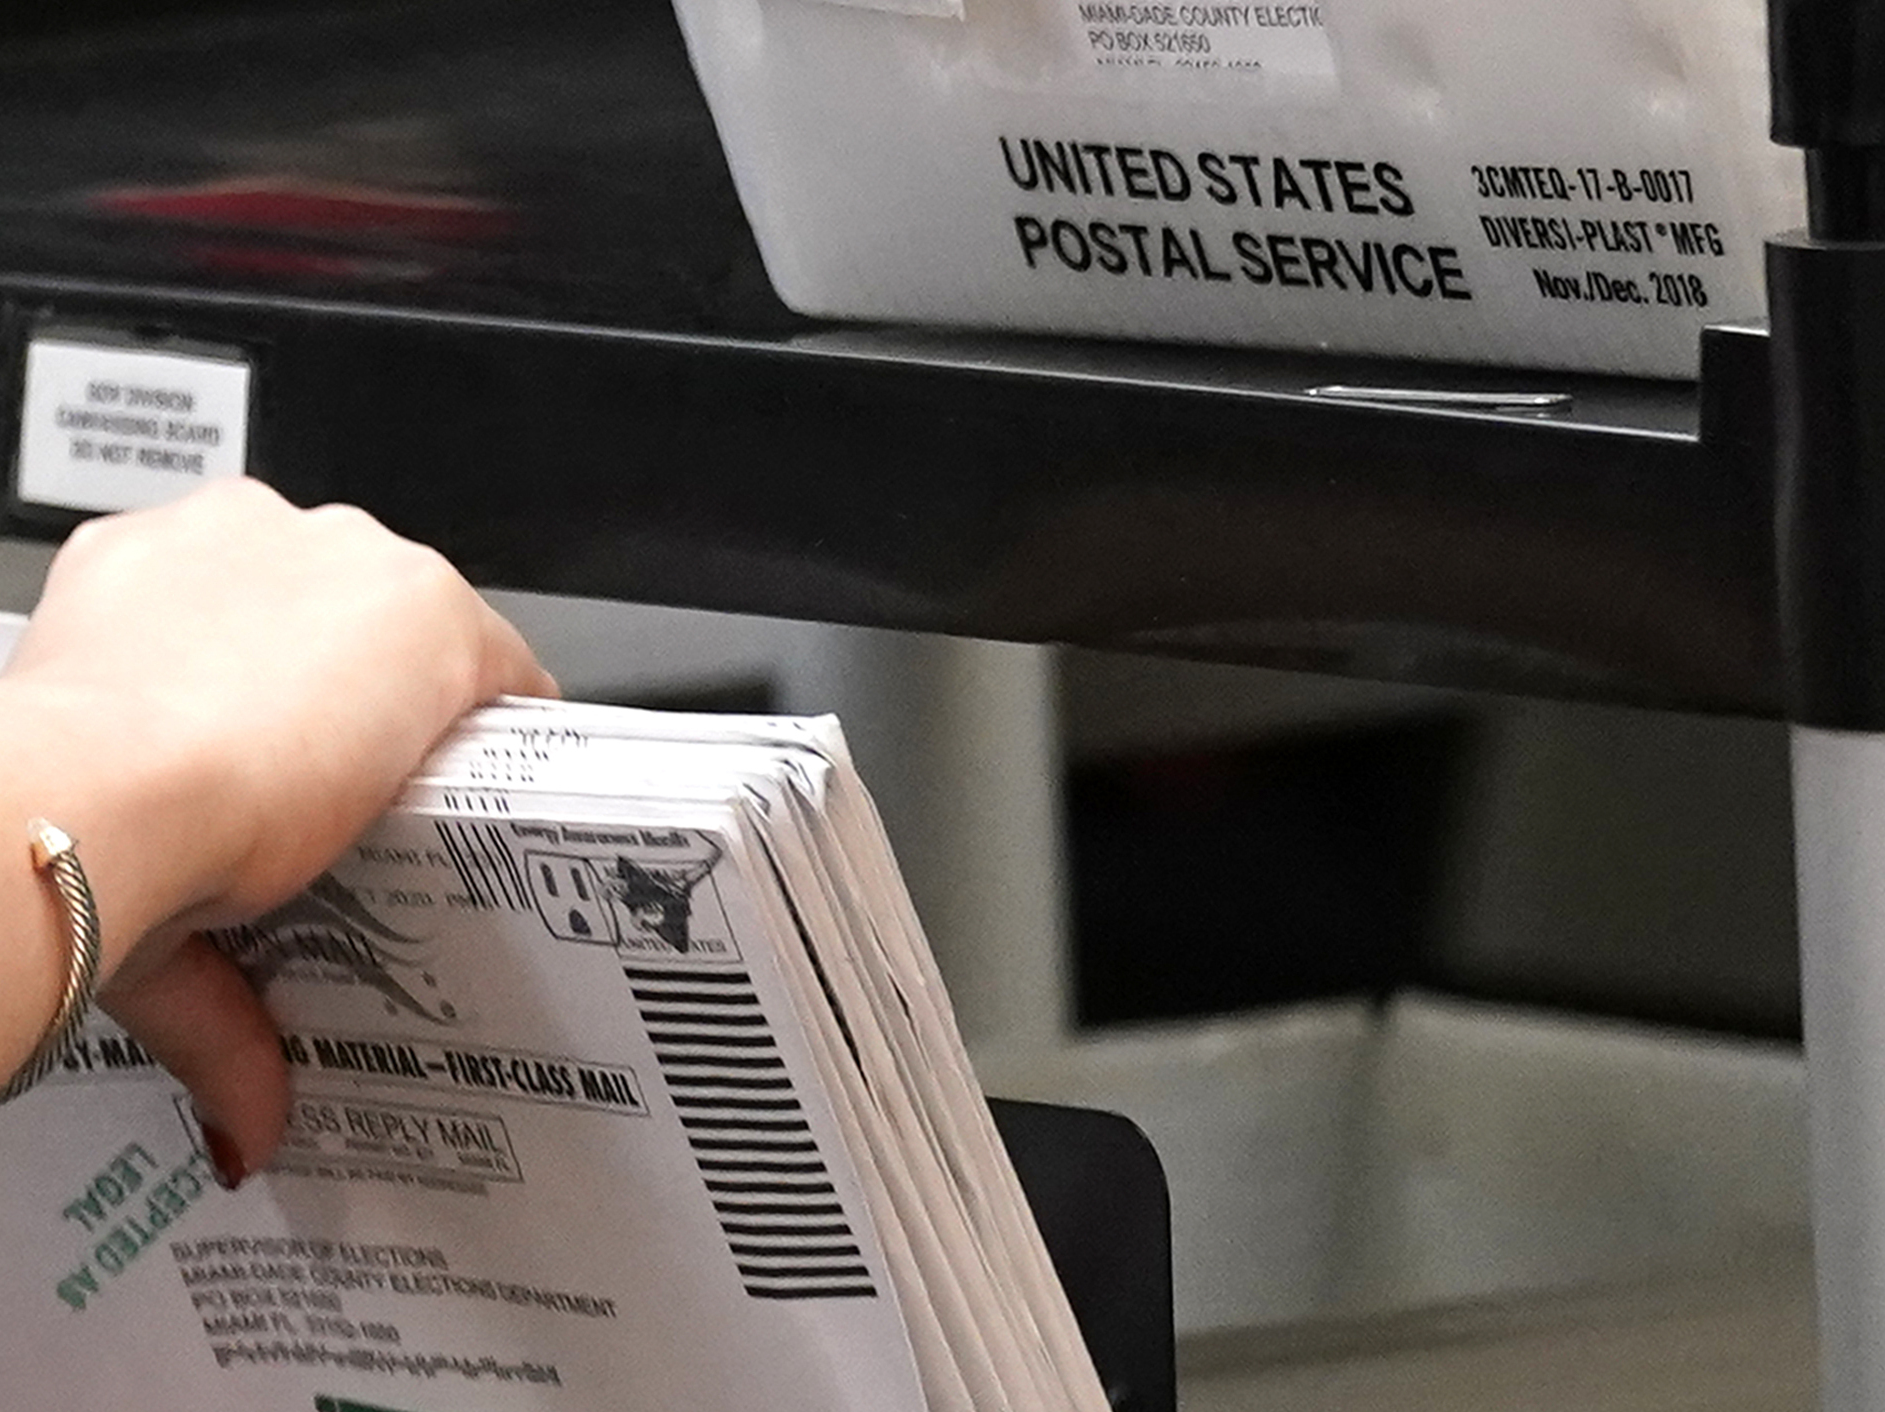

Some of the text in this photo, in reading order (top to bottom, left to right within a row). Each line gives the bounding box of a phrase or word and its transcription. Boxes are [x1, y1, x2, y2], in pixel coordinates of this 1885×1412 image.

[1078, 4, 1175, 26] MIAMI-DADE
[1178, 5, 1250, 27] COUNTY
[1088, 30, 1114, 51] PO
[1117, 31, 1152, 53] BOX
[998, 136, 1416, 218] UNITED STATES
[1013, 215, 1474, 302] POSTAL SERVICE
[1668, 221, 1725, 257] MFG
[1532, 266, 1709, 308] Nov./Dec. 2018
[576, 1067, 640, 1109] MAIL
[343, 1105, 433, 1145] REPLY
[435, 1118, 500, 1152] MAIL
[62, 1141, 160, 1234] LEGAL
[338, 1241, 449, 1272] ELECTIONS
